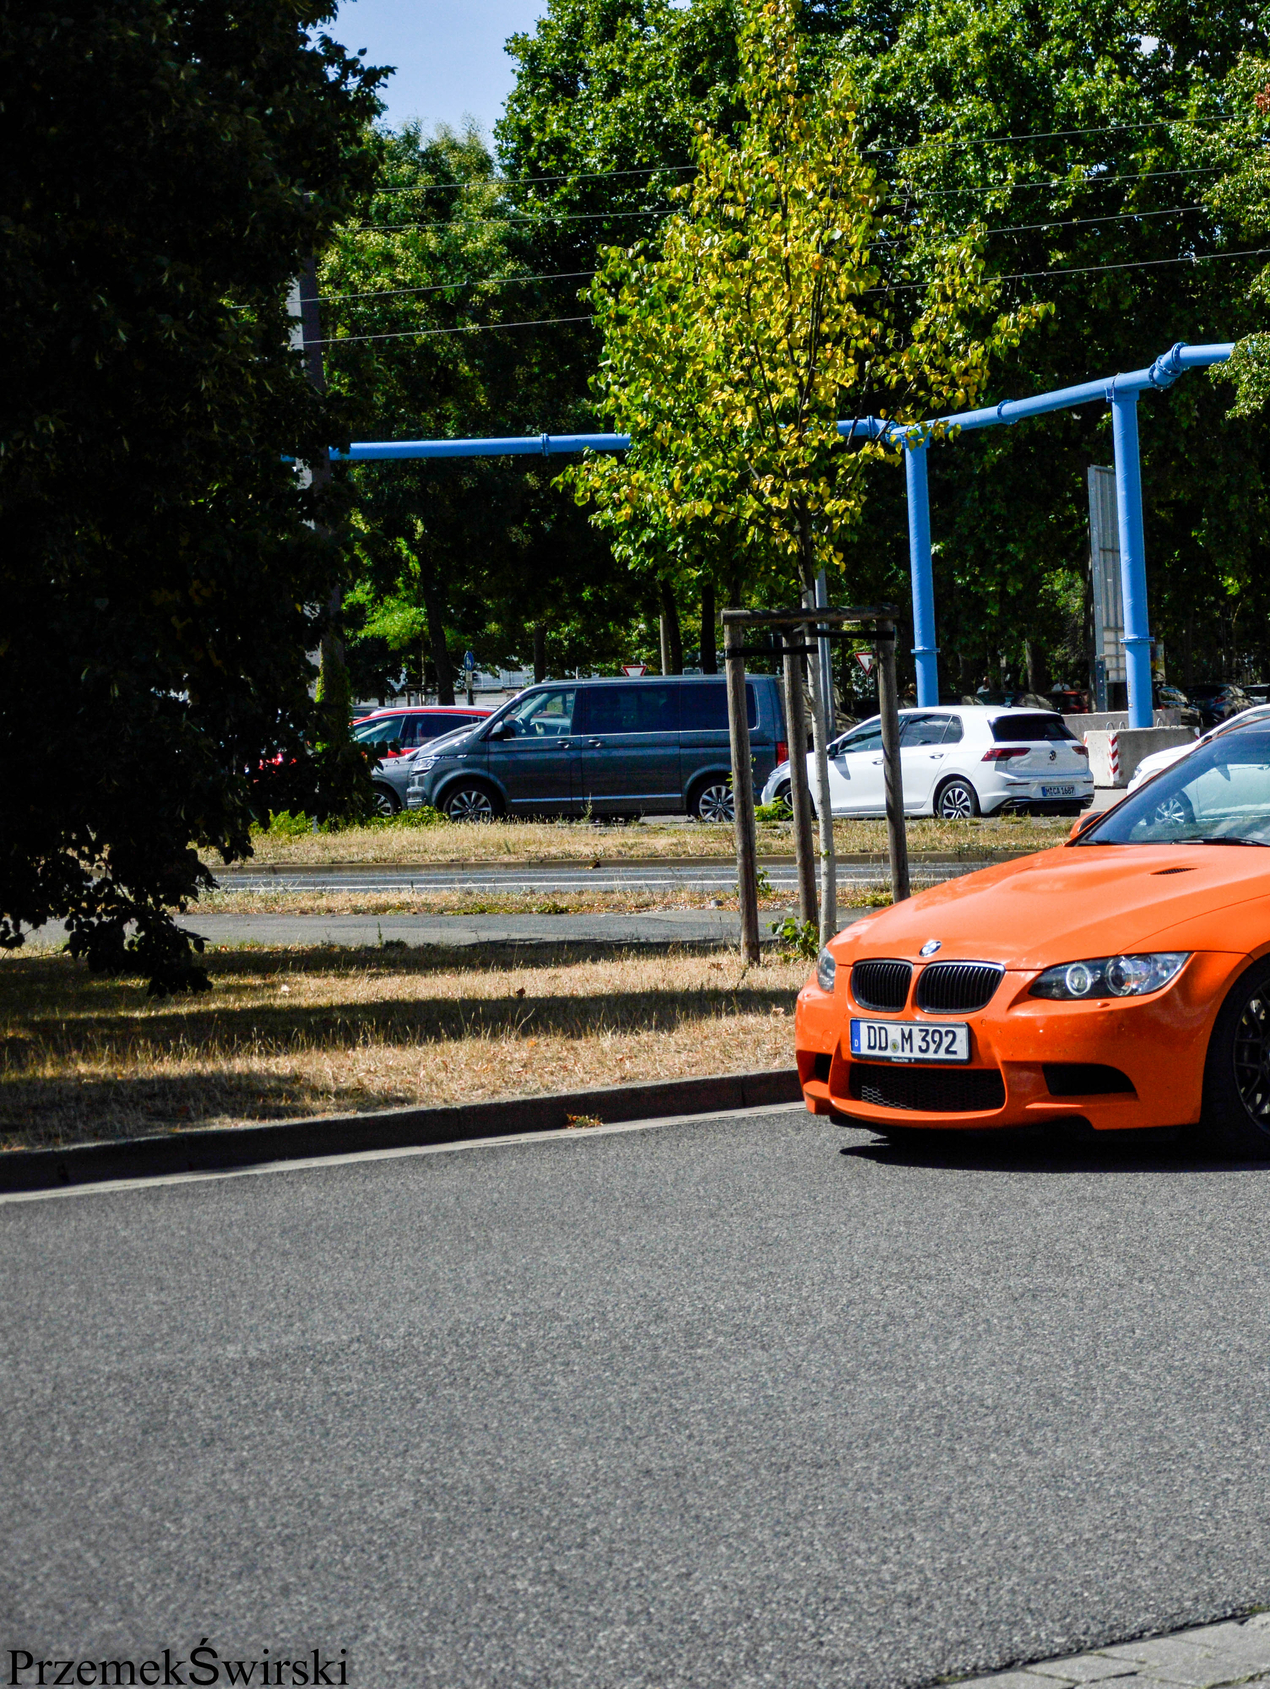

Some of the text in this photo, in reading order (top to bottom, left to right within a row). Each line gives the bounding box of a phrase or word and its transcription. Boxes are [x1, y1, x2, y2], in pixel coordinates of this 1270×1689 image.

[867, 1025, 958, 1055] DD M 392
